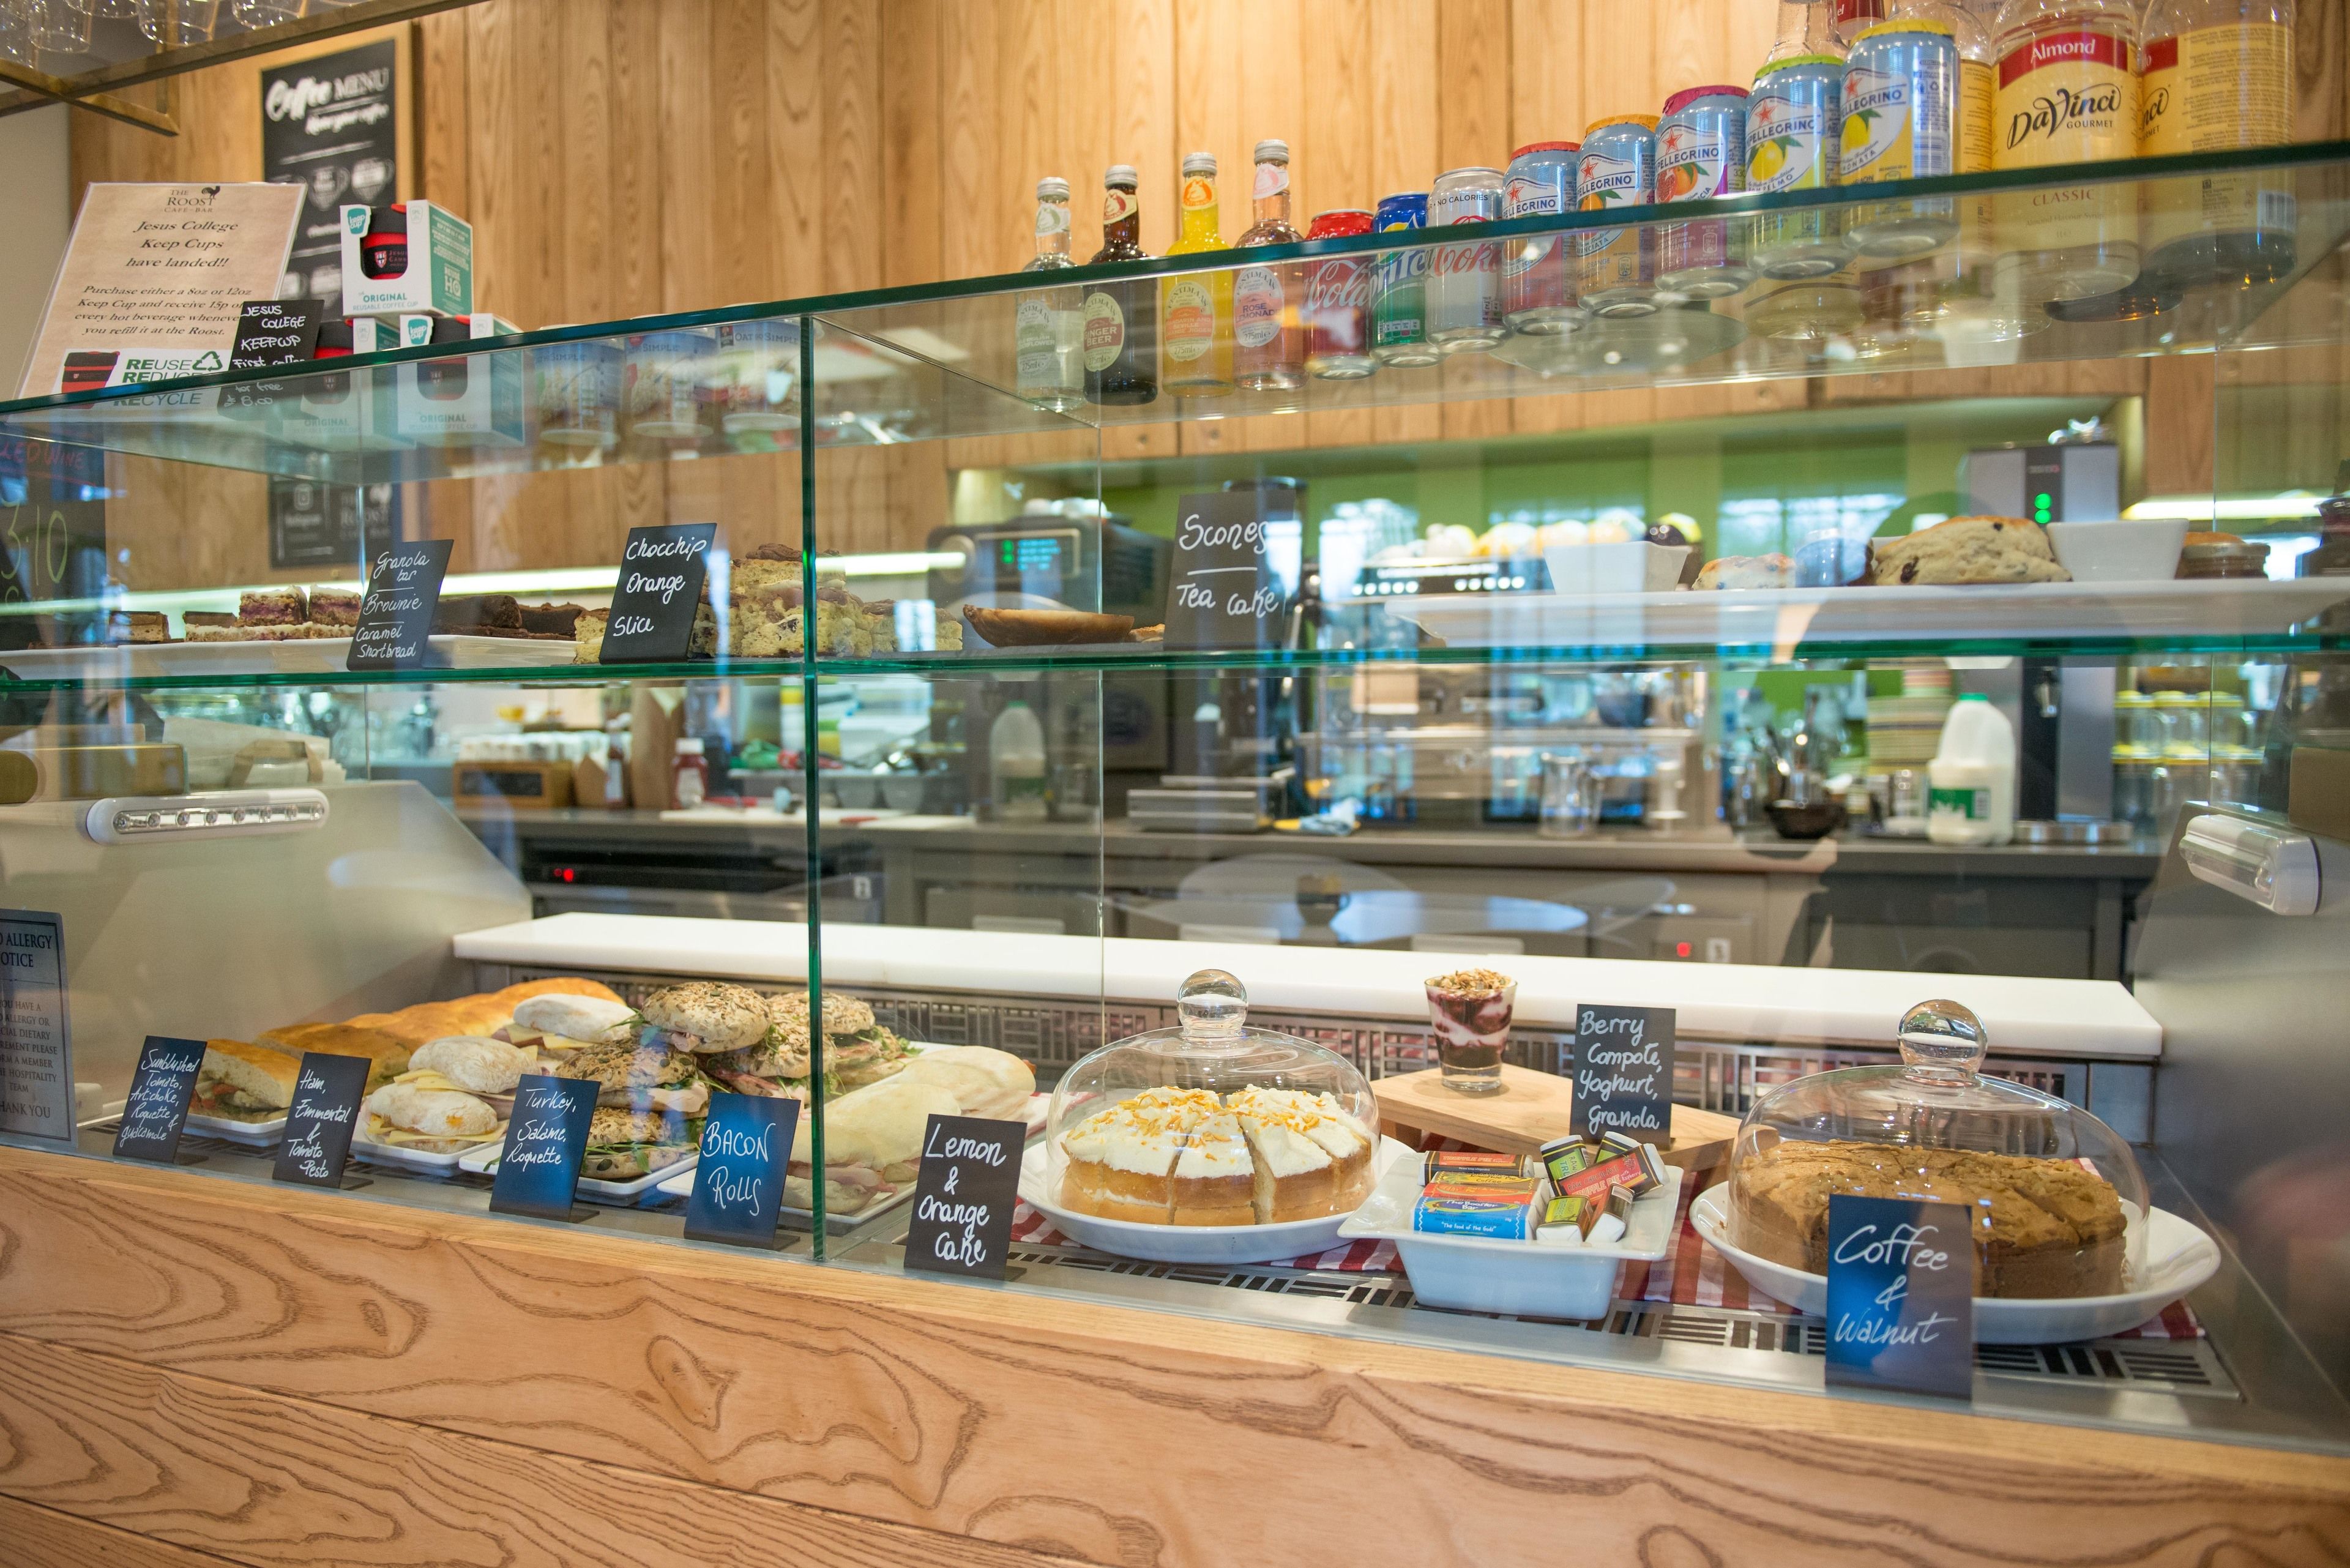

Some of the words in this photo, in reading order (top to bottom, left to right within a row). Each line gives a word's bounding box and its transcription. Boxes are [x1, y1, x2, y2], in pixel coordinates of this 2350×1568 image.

[2031, 39, 2096, 64] Almond
[334, 67, 390, 100] MENU
[2067, 120, 2113, 129] GOURMET
[166, 197, 214, 206] ROOST
[1437, 198, 1447, 207] NO
[1449, 194, 1488, 203] CALORIES
[2032, 189, 2095, 207] CLASSIC
[133, 221, 177, 233] Jesus
[182, 221, 239, 233] College
[349, 214, 365, 224] keep
[349, 221, 363, 230] cup
[140, 239, 180, 251] Keep
[184, 239, 224, 251] Cups
[125, 258, 162, 267] have
[165, 258, 229, 267] landed!!
[83, 285, 138, 296] Purchase
[363, 293, 407, 302] ORIGINAL
[78, 299, 108, 308] Keep
[112, 300, 137, 309] Cup
[209, 301, 229, 310] 15p
[241, 305, 283, 316] JESUS
[1243, 303, 1267, 313] ROSE
[75, 313, 108, 322] every
[132, 314, 185, 323] beverage
[261, 316, 306, 329] COLLEGE
[1085, 326, 1117, 338] GINGER
[1086, 335, 1112, 346] BEER
[126, 359, 192, 370] REUSE
[419, 414, 468, 424] ORIGINAL
[1179, 513, 1269, 554] Scones
[373, 551, 430, 580] Granola
[397, 569, 417, 582] bar
[626, 572, 686, 605] Orange
[1176, 583, 1217, 608] Tea
[363, 593, 422, 616] Brownie
[356, 625, 403, 643] Caramel
[613, 616, 654, 637] Slice
[357, 641, 417, 659] Shortbread
[6, 933, 52, 949] ALLERGY
[0, 951, 34, 968] OTICE
[15, 1001, 34, 1011] HAVE
[5, 1014, 37, 1025] ALLERGY
[39, 1017, 50, 1026] OR
[1580, 1010, 1644, 1047] Berry
[20, 1028, 51, 1040] DIETARY
[32, 1044, 58, 1055] PLEASE
[1587, 1042, 1663, 1073] Compote,
[21, 1057, 54, 1069] MEMBER
[141, 1048, 201, 1072] Sunblushed
[9, 1069, 58, 1083] HOSPITALITY
[300, 1069, 326, 1094] Ham,
[9, 1082, 29, 1092] TEAM
[1578, 1069, 1658, 1102] Yoghurt,
[0, 1102, 27, 1116] HANK
[29, 1105, 51, 1119] YOU
[131, 1102, 171, 1128] Roquette
[295, 1099, 352, 1123] Emmental
[1588, 1105, 1660, 1135] Granola
[307, 1122, 321, 1144] &
[703, 1121, 776, 1162] BACON
[288, 1138, 324, 1159] Tomato
[925, 1123, 1007, 1167] Lemon
[505, 1142, 562, 1172] Roquette
[299, 1159, 329, 1178] Pesto
[944, 1166, 960, 1195] &
[1567, 1182, 1581, 1191] RAW
[1607, 1174, 1622, 1186] PIE
[918, 1195, 990, 1239] Orange
[1834, 1223, 1949, 1272] Coffee
[1874, 1274, 1909, 1311] &
[1834, 1307, 1958, 1345] Walnut
